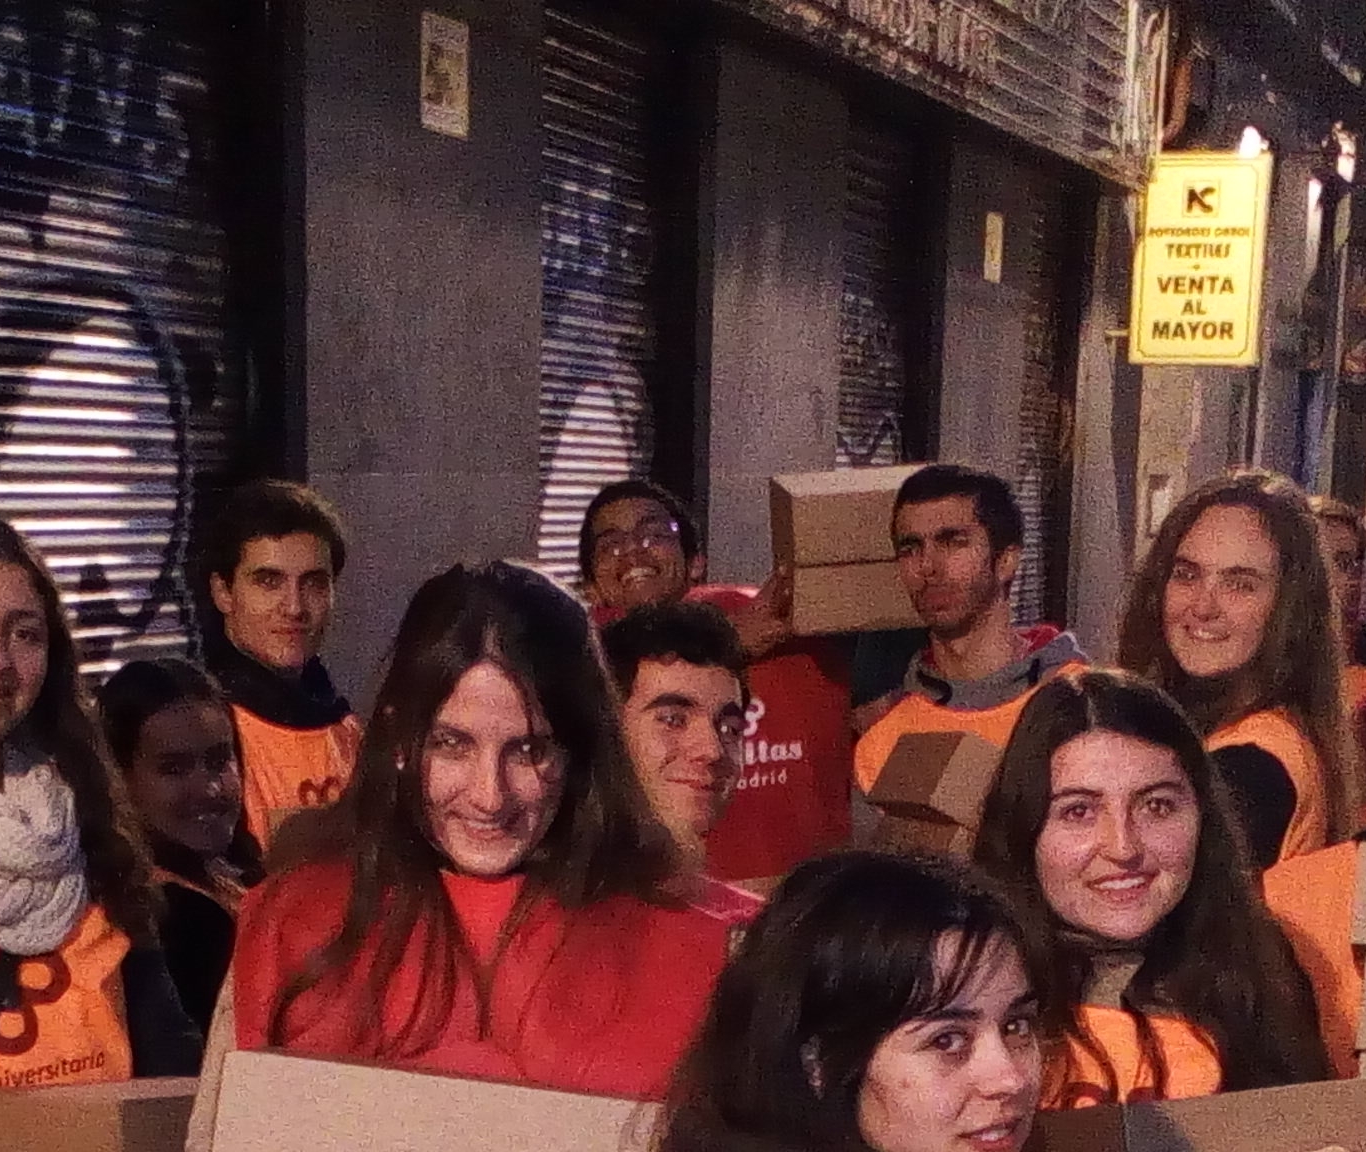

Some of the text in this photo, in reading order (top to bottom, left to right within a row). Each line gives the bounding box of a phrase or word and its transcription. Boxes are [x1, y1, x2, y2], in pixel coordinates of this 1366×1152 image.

[1157, 275, 1235, 295] VENTA
[1181, 299, 1207, 316] AL
[1151, 320, 1234, 341] MAYOR
[745, 740, 803, 765] itas
[736, 768, 788, 790] adrid
